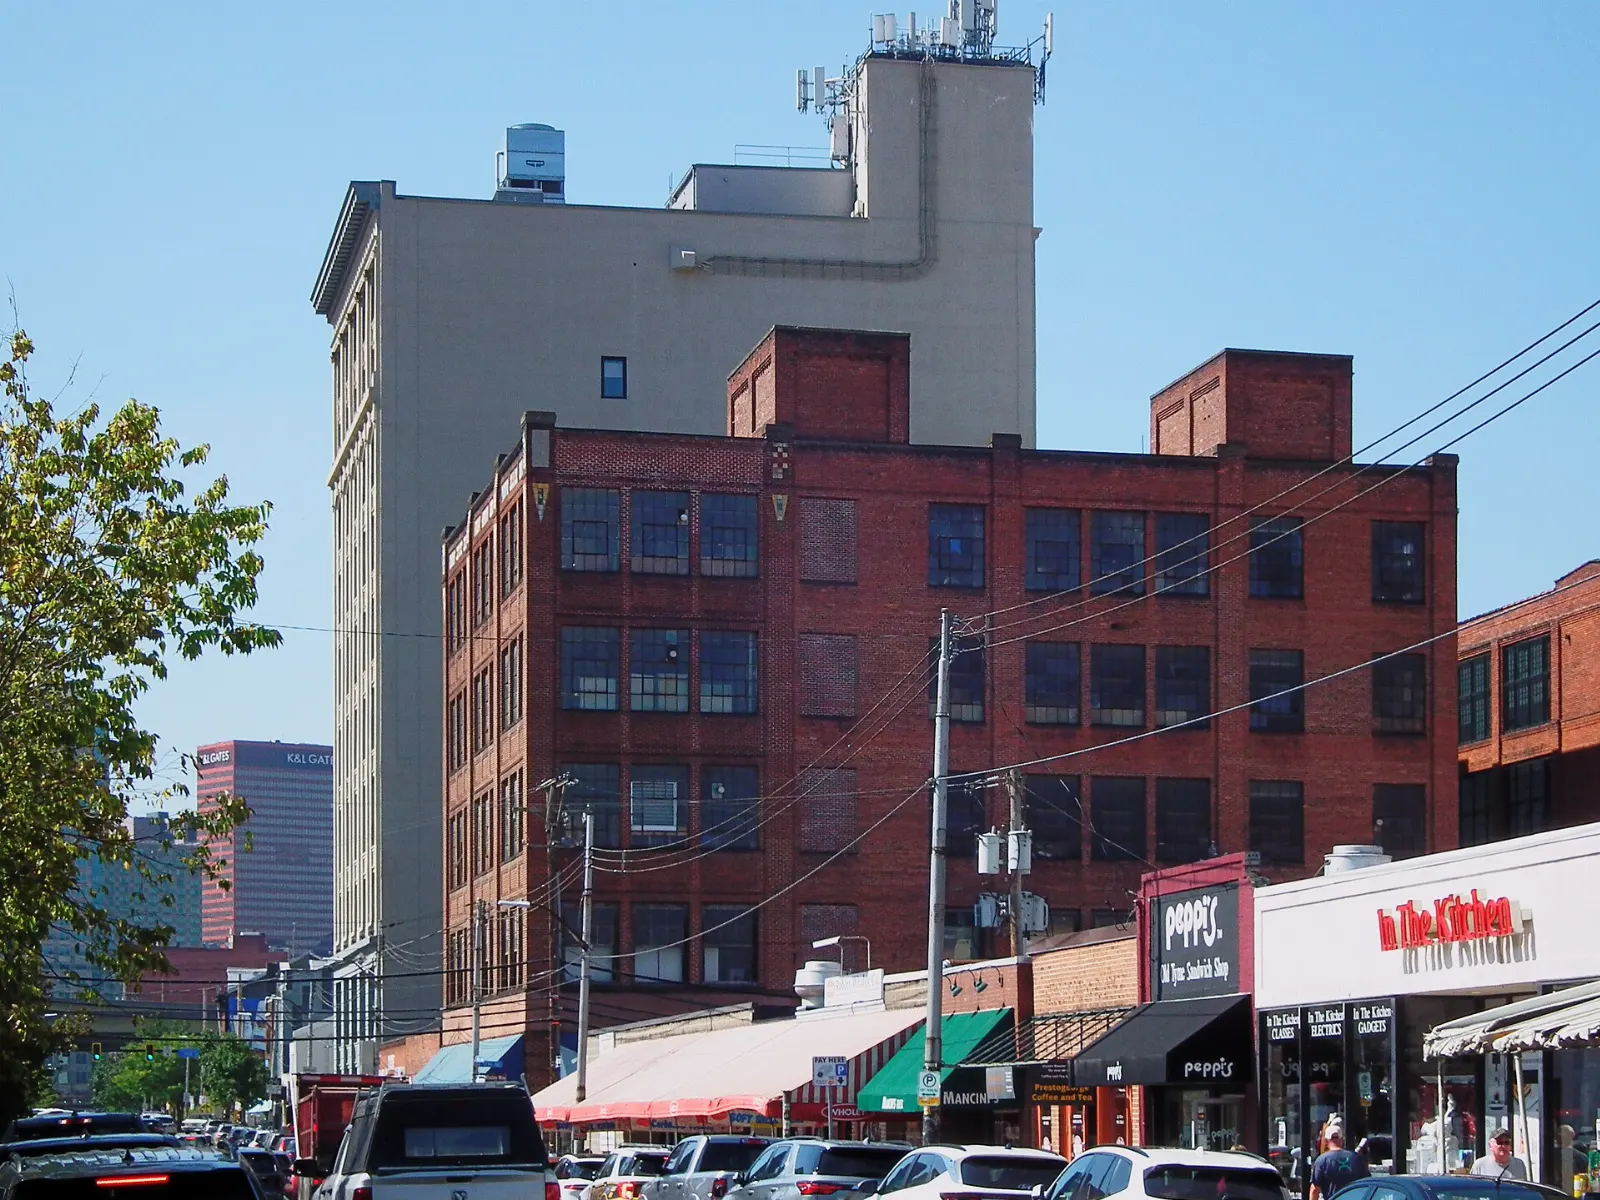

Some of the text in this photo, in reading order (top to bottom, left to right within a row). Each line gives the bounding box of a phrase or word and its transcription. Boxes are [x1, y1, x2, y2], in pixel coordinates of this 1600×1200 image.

[210, 750, 230, 763] GATES
[287, 753, 334, 765] K&L GATE
[1377, 888, 1514, 951] In The Kitchen
[1161, 957, 1229, 987] Old Tyme Sandwich Shop
[1308, 1009, 1344, 1023] In The Kitchen
[1353, 1005, 1392, 1020] In The Kitchen
[1267, 1016, 1273, 1027] In
[1273, 1015, 1282, 1026] The
[1358, 1020, 1387, 1034] GADGETS
[1271, 1027, 1294, 1039] CLASSES
[1311, 1023, 1342, 1037] ELECTRICS
[837, 1065, 844, 1075] P
[1185, 1057, 1234, 1077] peppi's
[926, 1075, 933, 1085] P
[1032, 1093, 1059, 1101] Coffee
[1077, 1093, 1092, 1101] Tea
